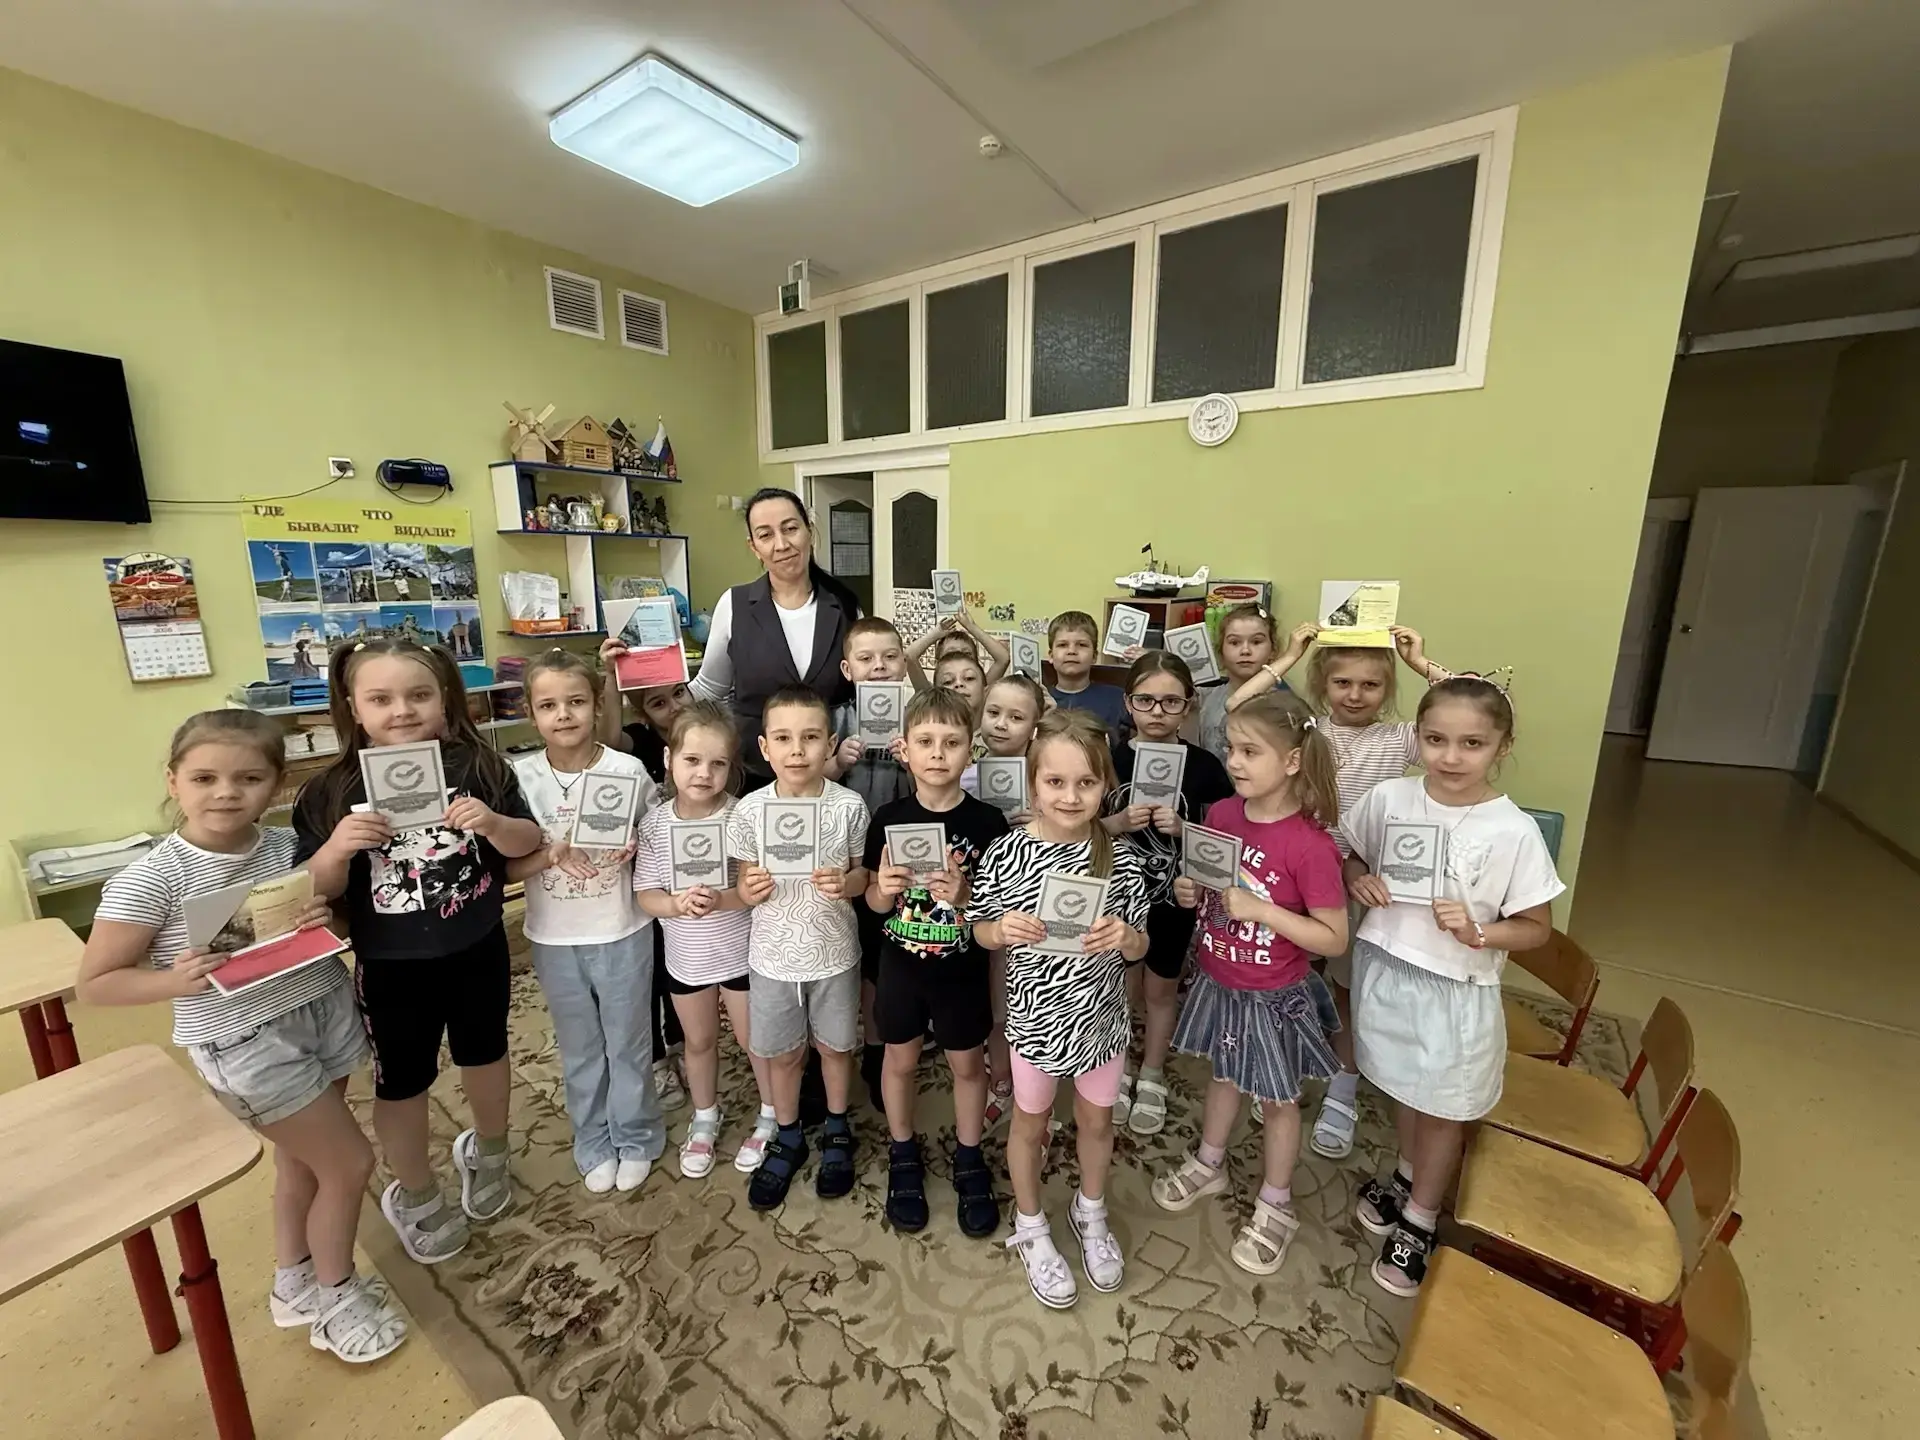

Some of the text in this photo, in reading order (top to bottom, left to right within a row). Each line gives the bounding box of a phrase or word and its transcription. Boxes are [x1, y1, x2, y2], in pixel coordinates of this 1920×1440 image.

[252, 504, 284, 517] ГДЕ
[362, 509, 393, 520] ЧТО
[287, 521, 359, 534] БЫВАЛИ?
[394, 524, 456, 538] ВИДАЛИ?
[1242, 846, 1265, 868] KE
